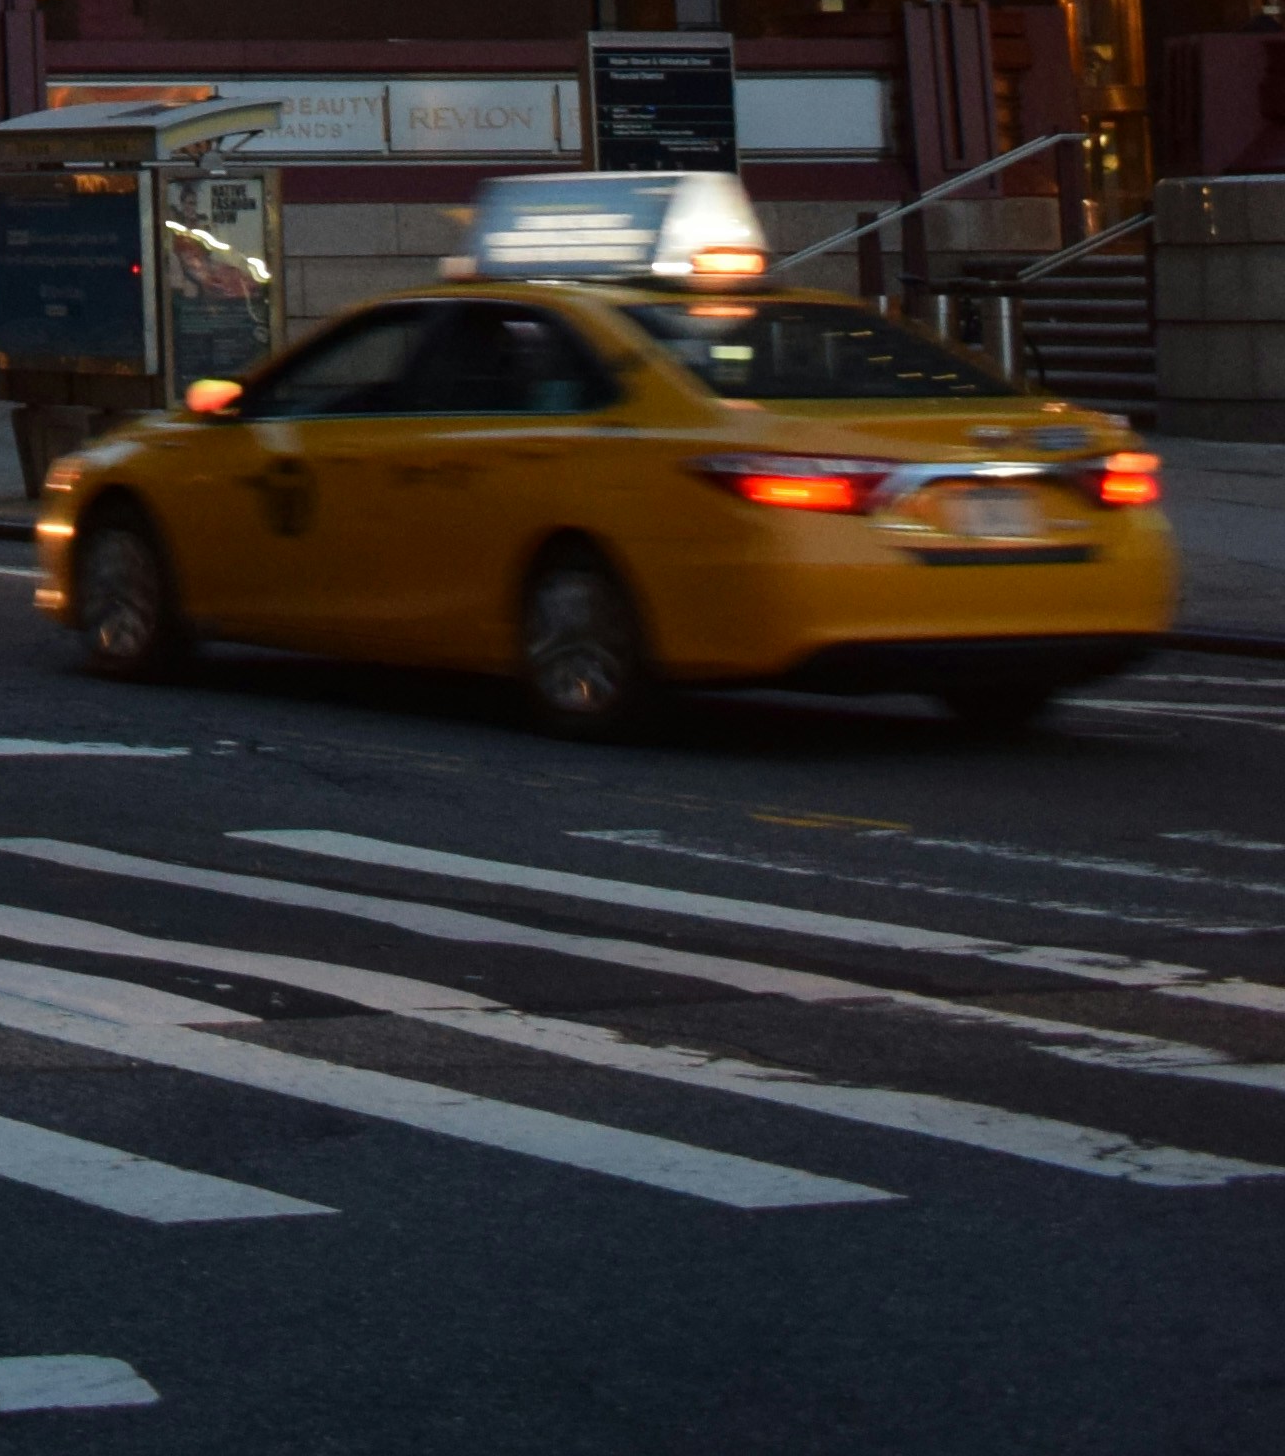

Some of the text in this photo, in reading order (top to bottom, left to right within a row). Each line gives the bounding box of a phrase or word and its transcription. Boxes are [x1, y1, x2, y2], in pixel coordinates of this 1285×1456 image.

[281, 96, 381, 116] BEAUTY
[409, 106, 533, 131] REVLON
[211, 196, 257, 210] FASHION
